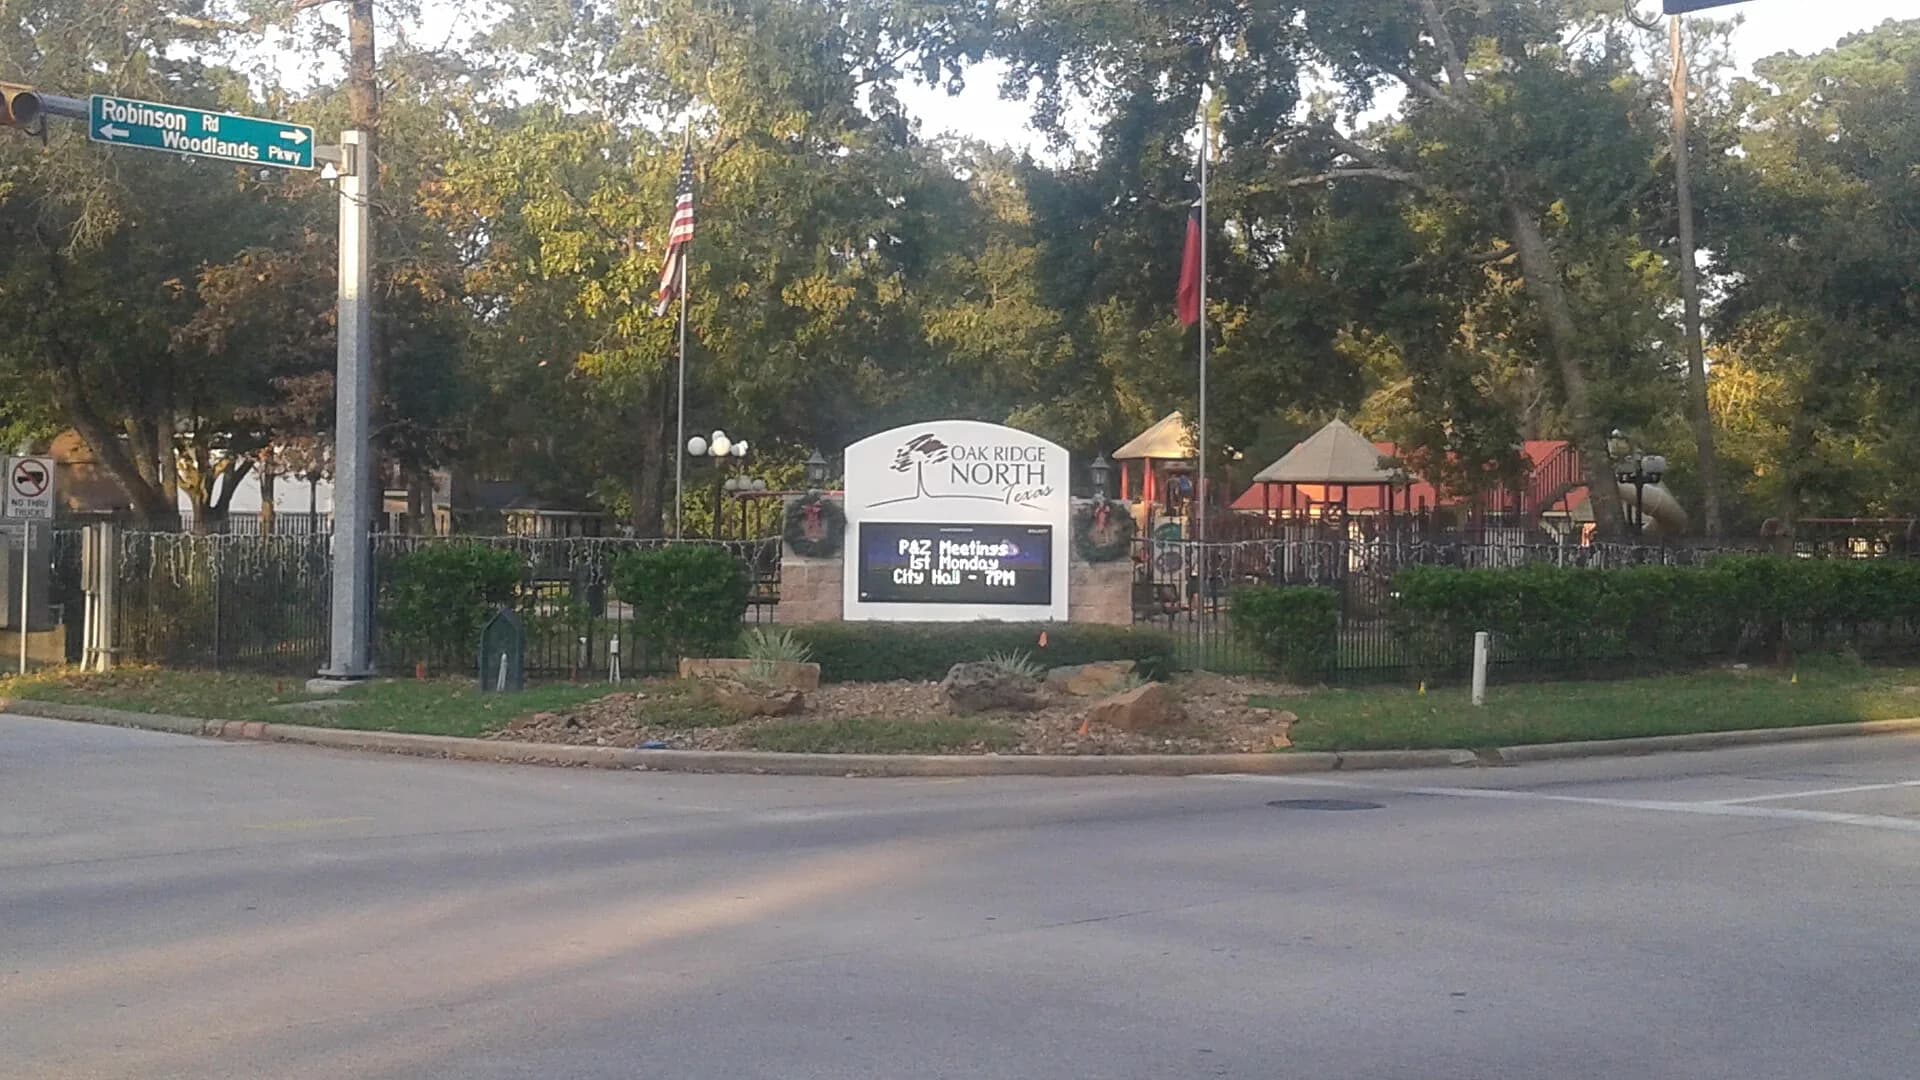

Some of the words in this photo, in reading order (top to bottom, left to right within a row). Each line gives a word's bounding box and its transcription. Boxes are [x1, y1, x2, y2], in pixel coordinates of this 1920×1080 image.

[102, 98, 186, 131] Robinson
[202, 114, 220, 132] Rd
[162, 129, 259, 160] Woodlands
[268, 146, 301, 165] Pkwy
[951, 446, 988, 461] OAK
[994, 446, 1046, 462] RIDGE
[951, 463, 1045, 485] NORTH
[1002, 483, 1054, 505] Texas
[899, 539, 932, 556] P&Z
[939, 555, 999, 571] Monday
[893, 569, 924, 585] City
[931, 570, 960, 585] Hall
[985, 570, 1016, 586] 7PM
